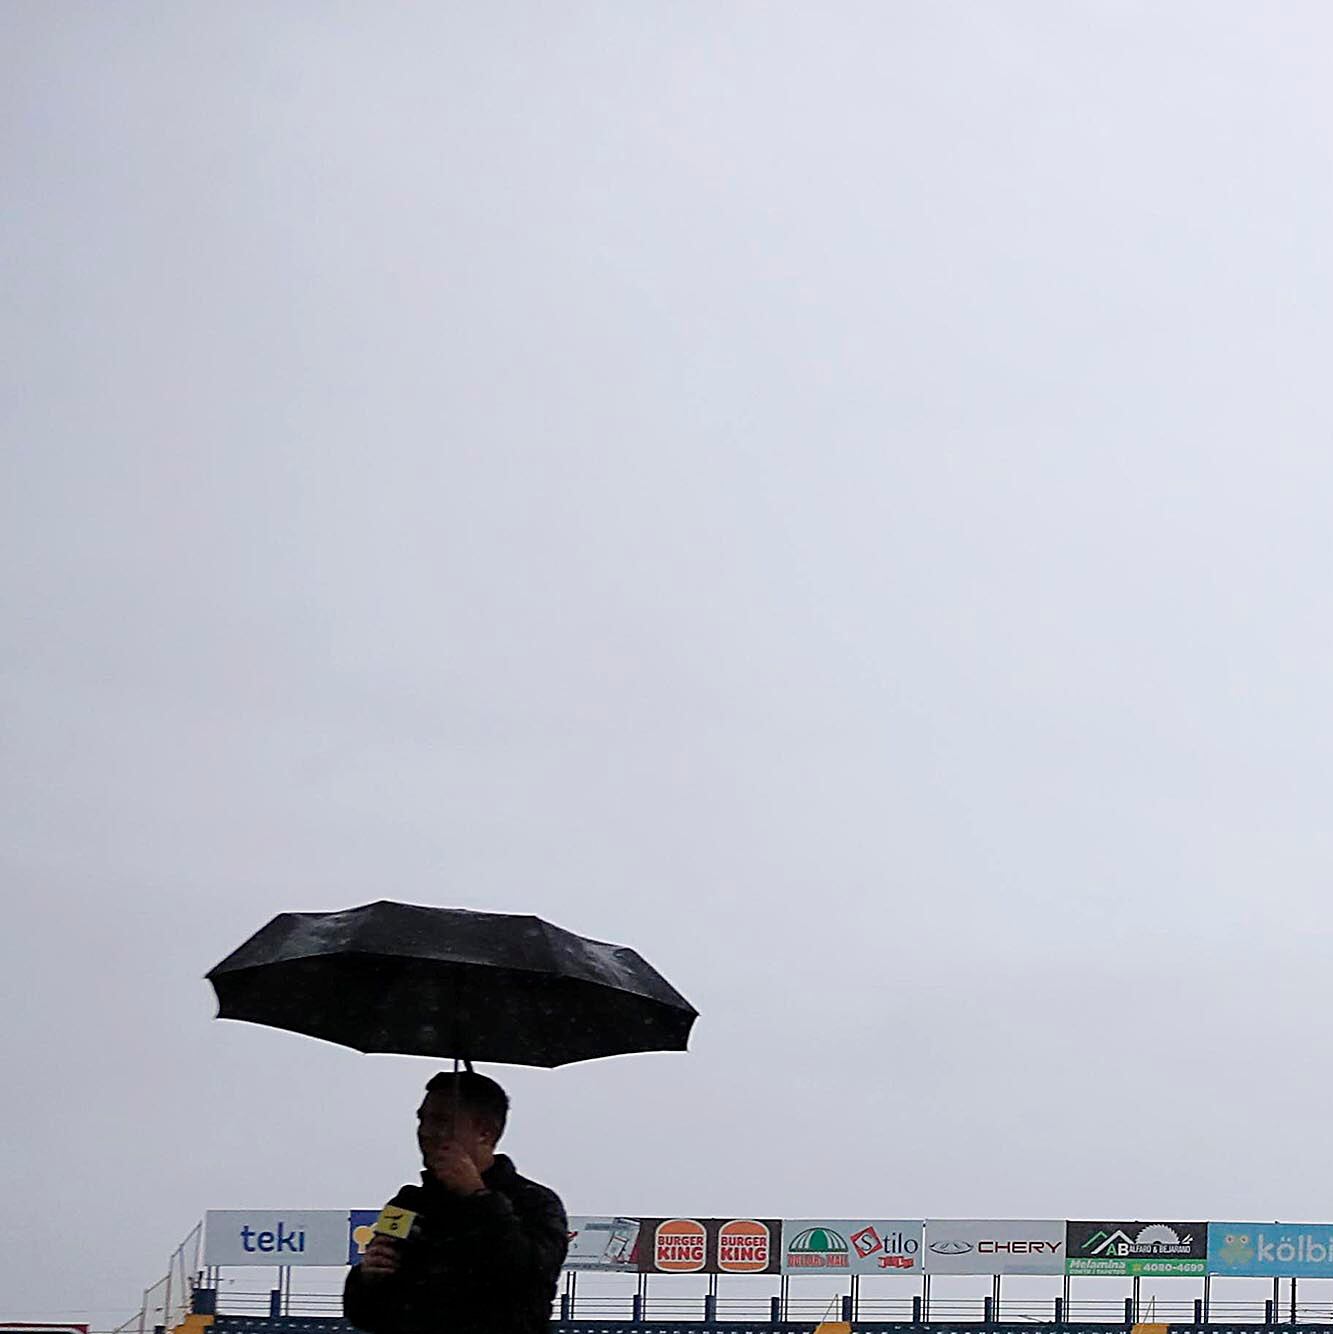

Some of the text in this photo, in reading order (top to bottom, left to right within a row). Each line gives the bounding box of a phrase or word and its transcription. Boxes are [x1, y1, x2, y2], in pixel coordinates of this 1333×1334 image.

[241, 1222, 305, 1253] teki
[658, 1237, 704, 1248] BURGER
[720, 1237, 767, 1248] BURGER
[861, 1232, 918, 1254] Stilo
[658, 1247, 704, 1261] KING
[978, 1241, 1062, 1253] CHERY
[720, 1248, 767, 1262] KING
